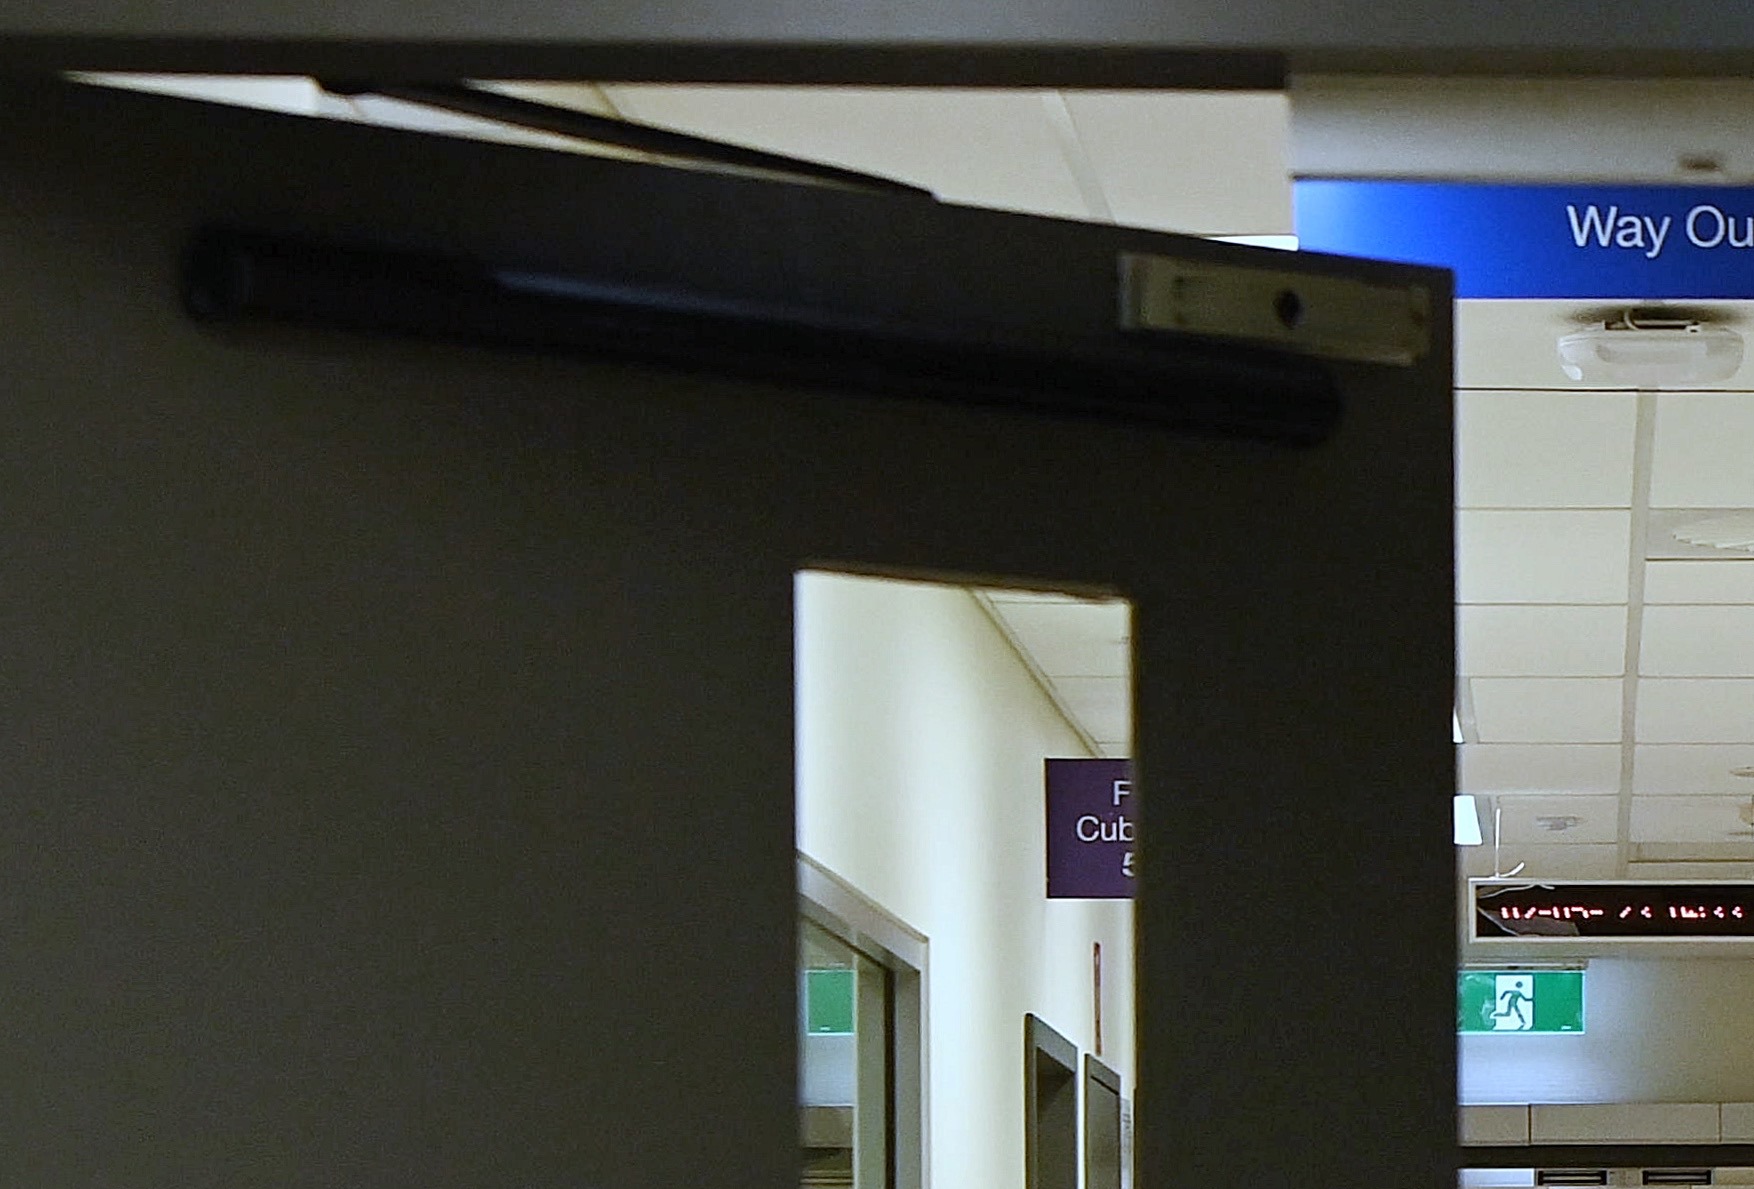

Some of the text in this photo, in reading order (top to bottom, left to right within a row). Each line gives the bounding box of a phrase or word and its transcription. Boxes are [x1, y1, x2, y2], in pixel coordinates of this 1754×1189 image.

[1566, 204, 1672, 259] Way
[1112, 779, 1133, 806] F
[1076, 815, 1136, 842] Cub
